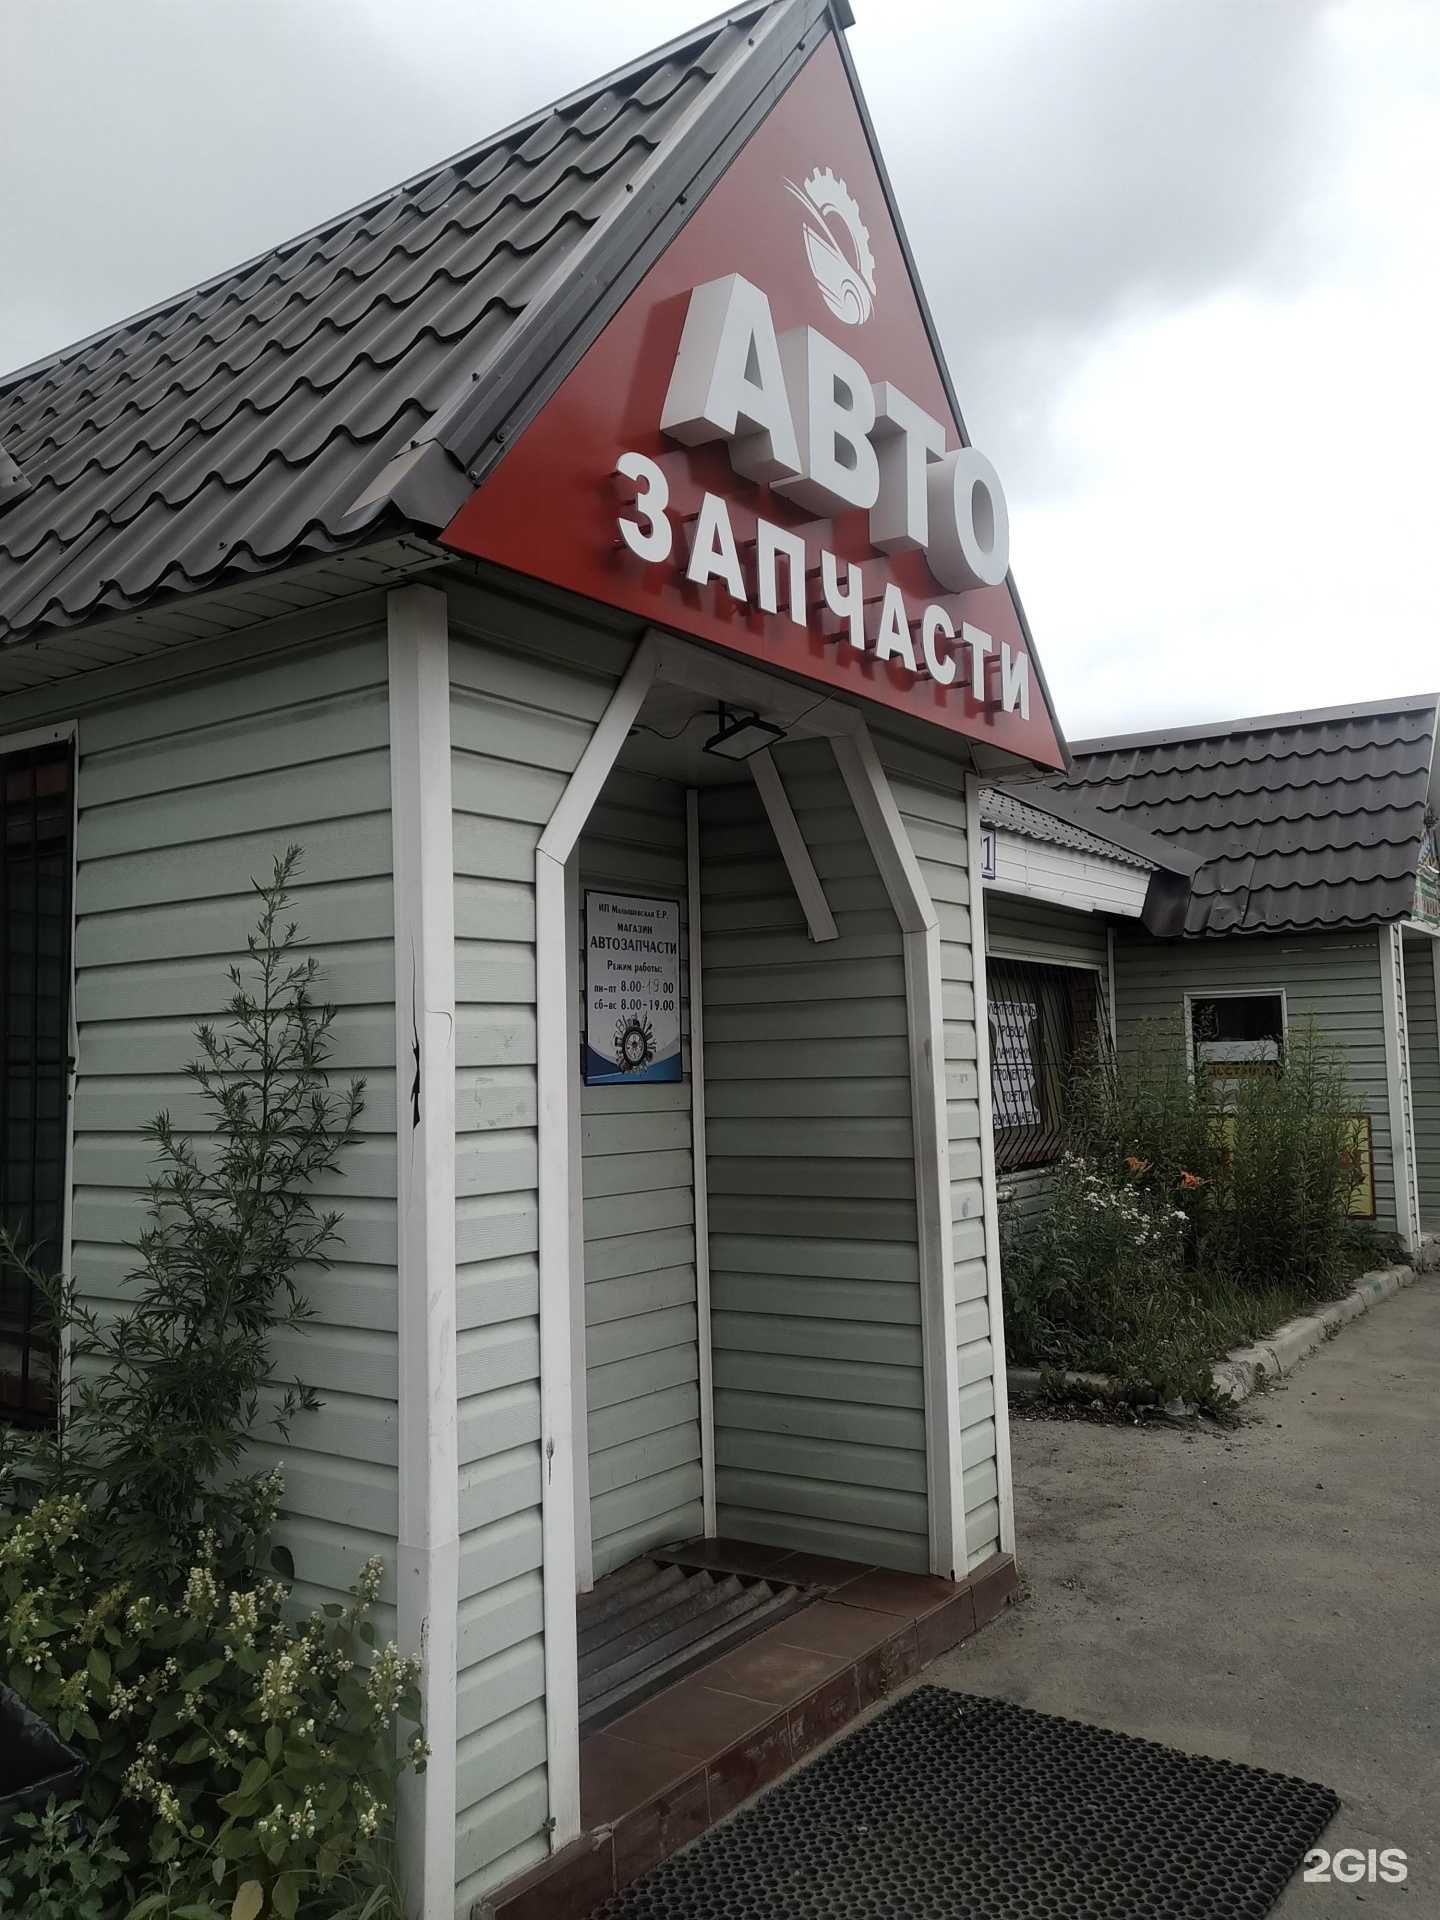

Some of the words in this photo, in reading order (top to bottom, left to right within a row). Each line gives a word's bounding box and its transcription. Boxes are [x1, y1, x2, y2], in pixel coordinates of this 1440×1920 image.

[676, 272, 1010, 592] АВТО
[616, 452, 1030, 720] ЗАПЧАСТИ
[598, 903, 609, 913] ИП
[590, 935, 677, 955] АВТОЗАПЧАСТИ
[607, 959, 632, 971] Режим
[594, 998, 617, 1010] сб-вс
